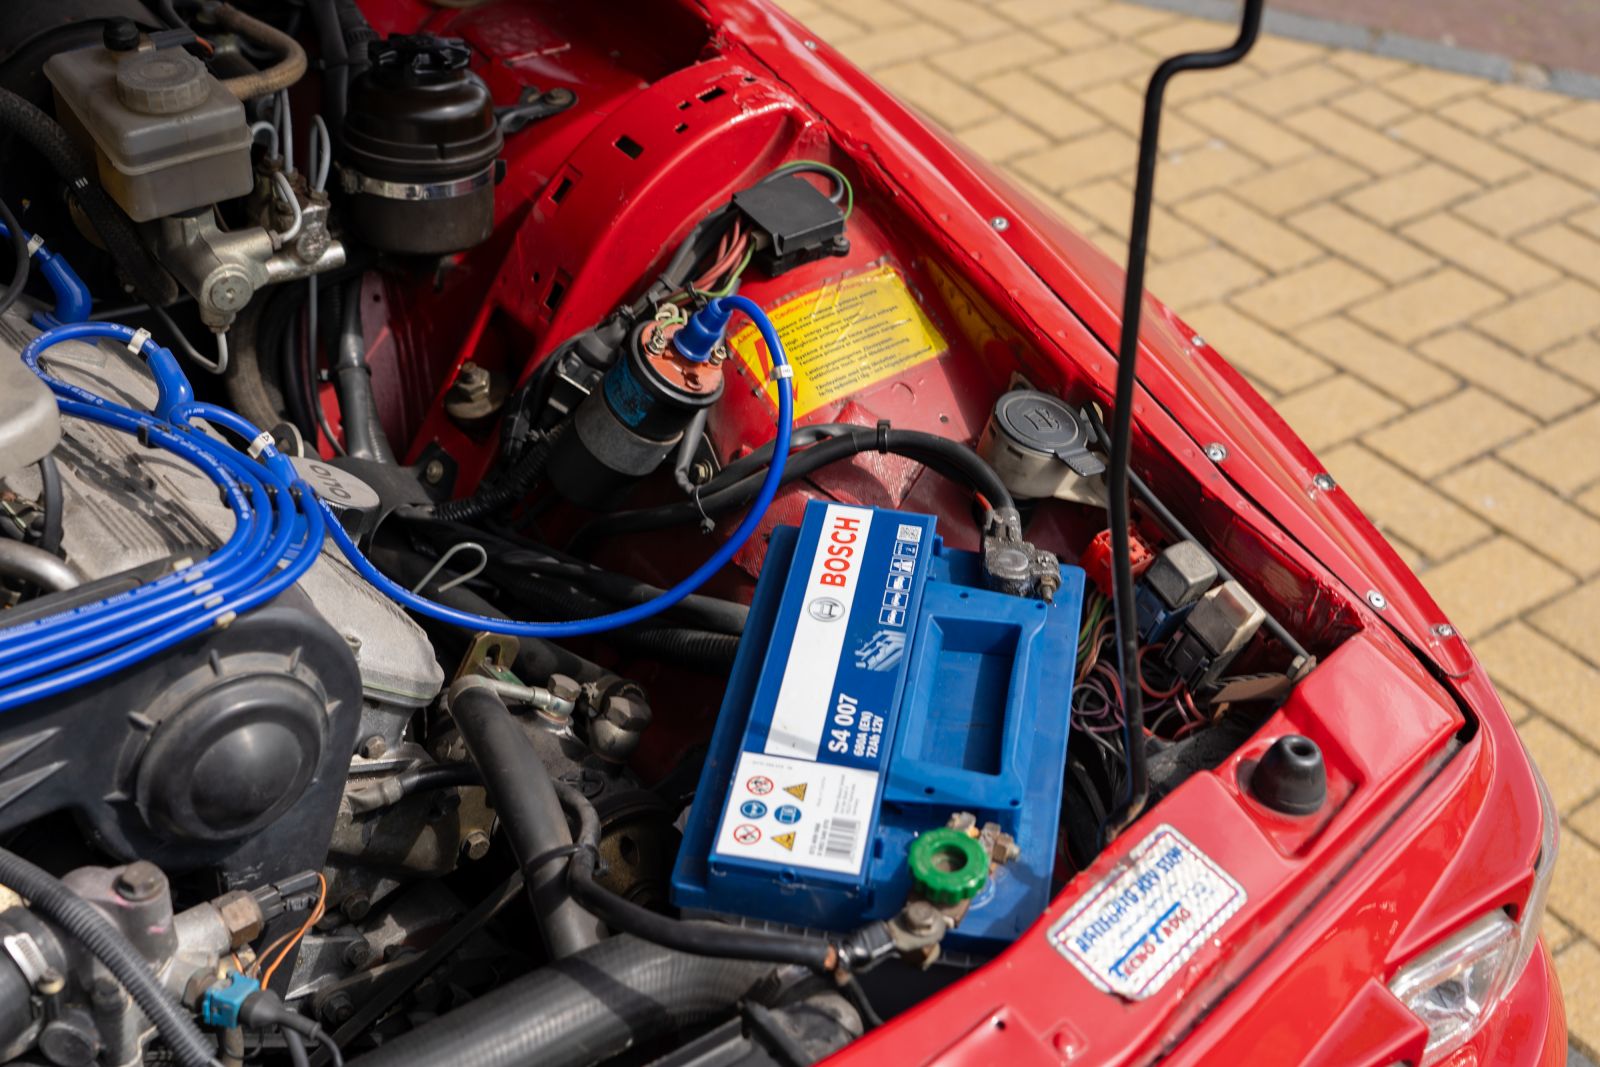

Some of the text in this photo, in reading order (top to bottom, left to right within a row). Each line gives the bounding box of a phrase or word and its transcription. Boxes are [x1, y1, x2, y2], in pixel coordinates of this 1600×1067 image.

[820, 516, 861, 588] BOSCH
[834, 693, 858, 727] 007
[858, 711, 874, 732] (EN)
[828, 729, 851, 754] S4
[866, 715, 884, 758] 72Ah 12V
